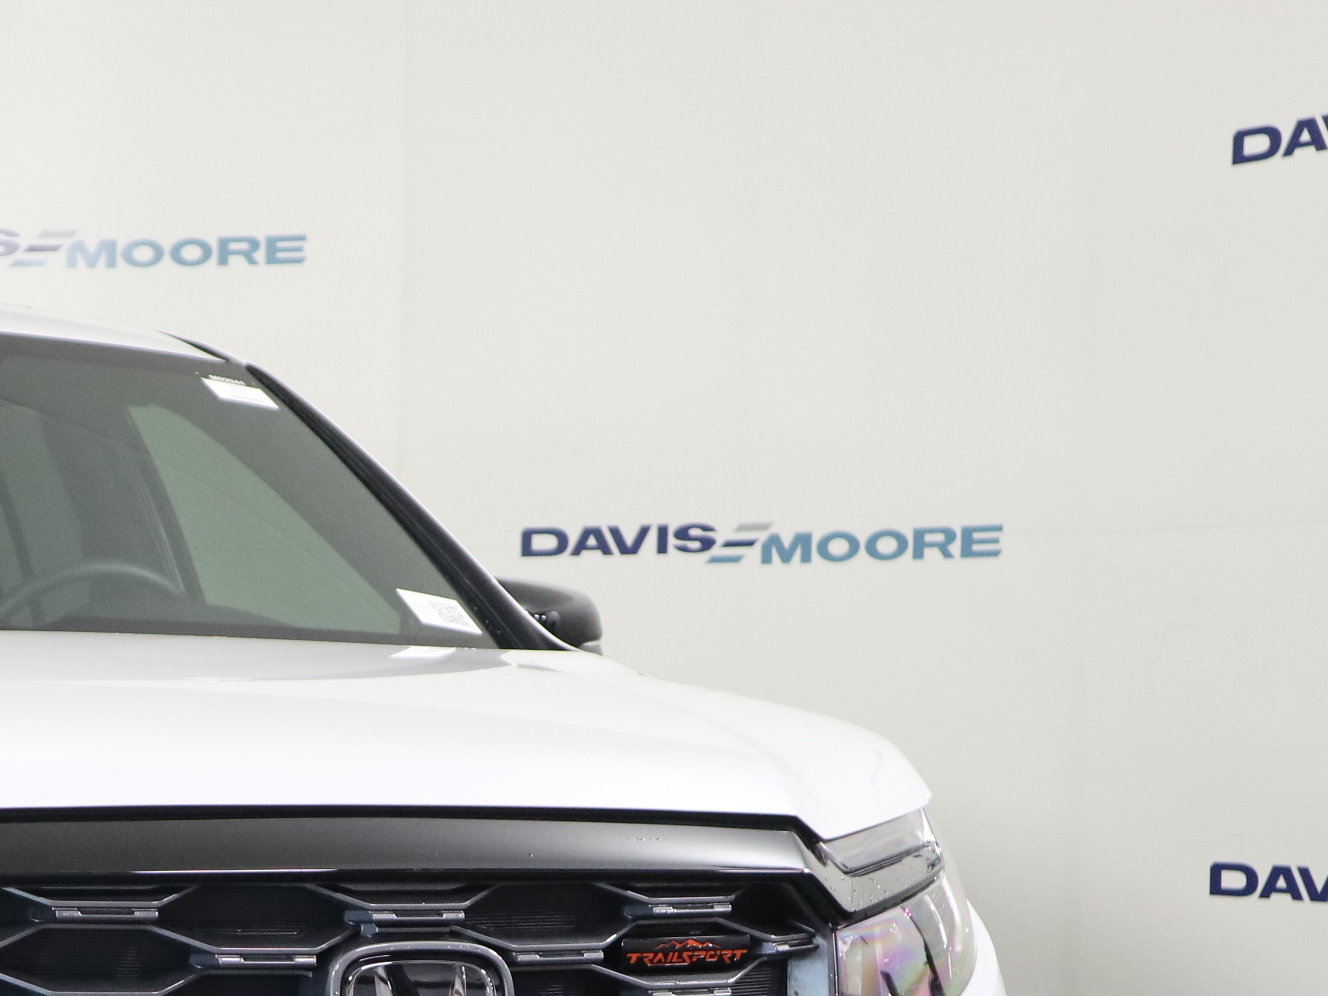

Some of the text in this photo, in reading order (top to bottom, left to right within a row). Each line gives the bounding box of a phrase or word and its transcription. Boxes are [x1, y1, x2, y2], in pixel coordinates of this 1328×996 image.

[1231, 113, 1328, 165] DA
[66, 234, 308, 269] MOORE
[520, 523, 1004, 565] DAVIS MOORE
[625, 949, 748, 966] TRAILSPORT
